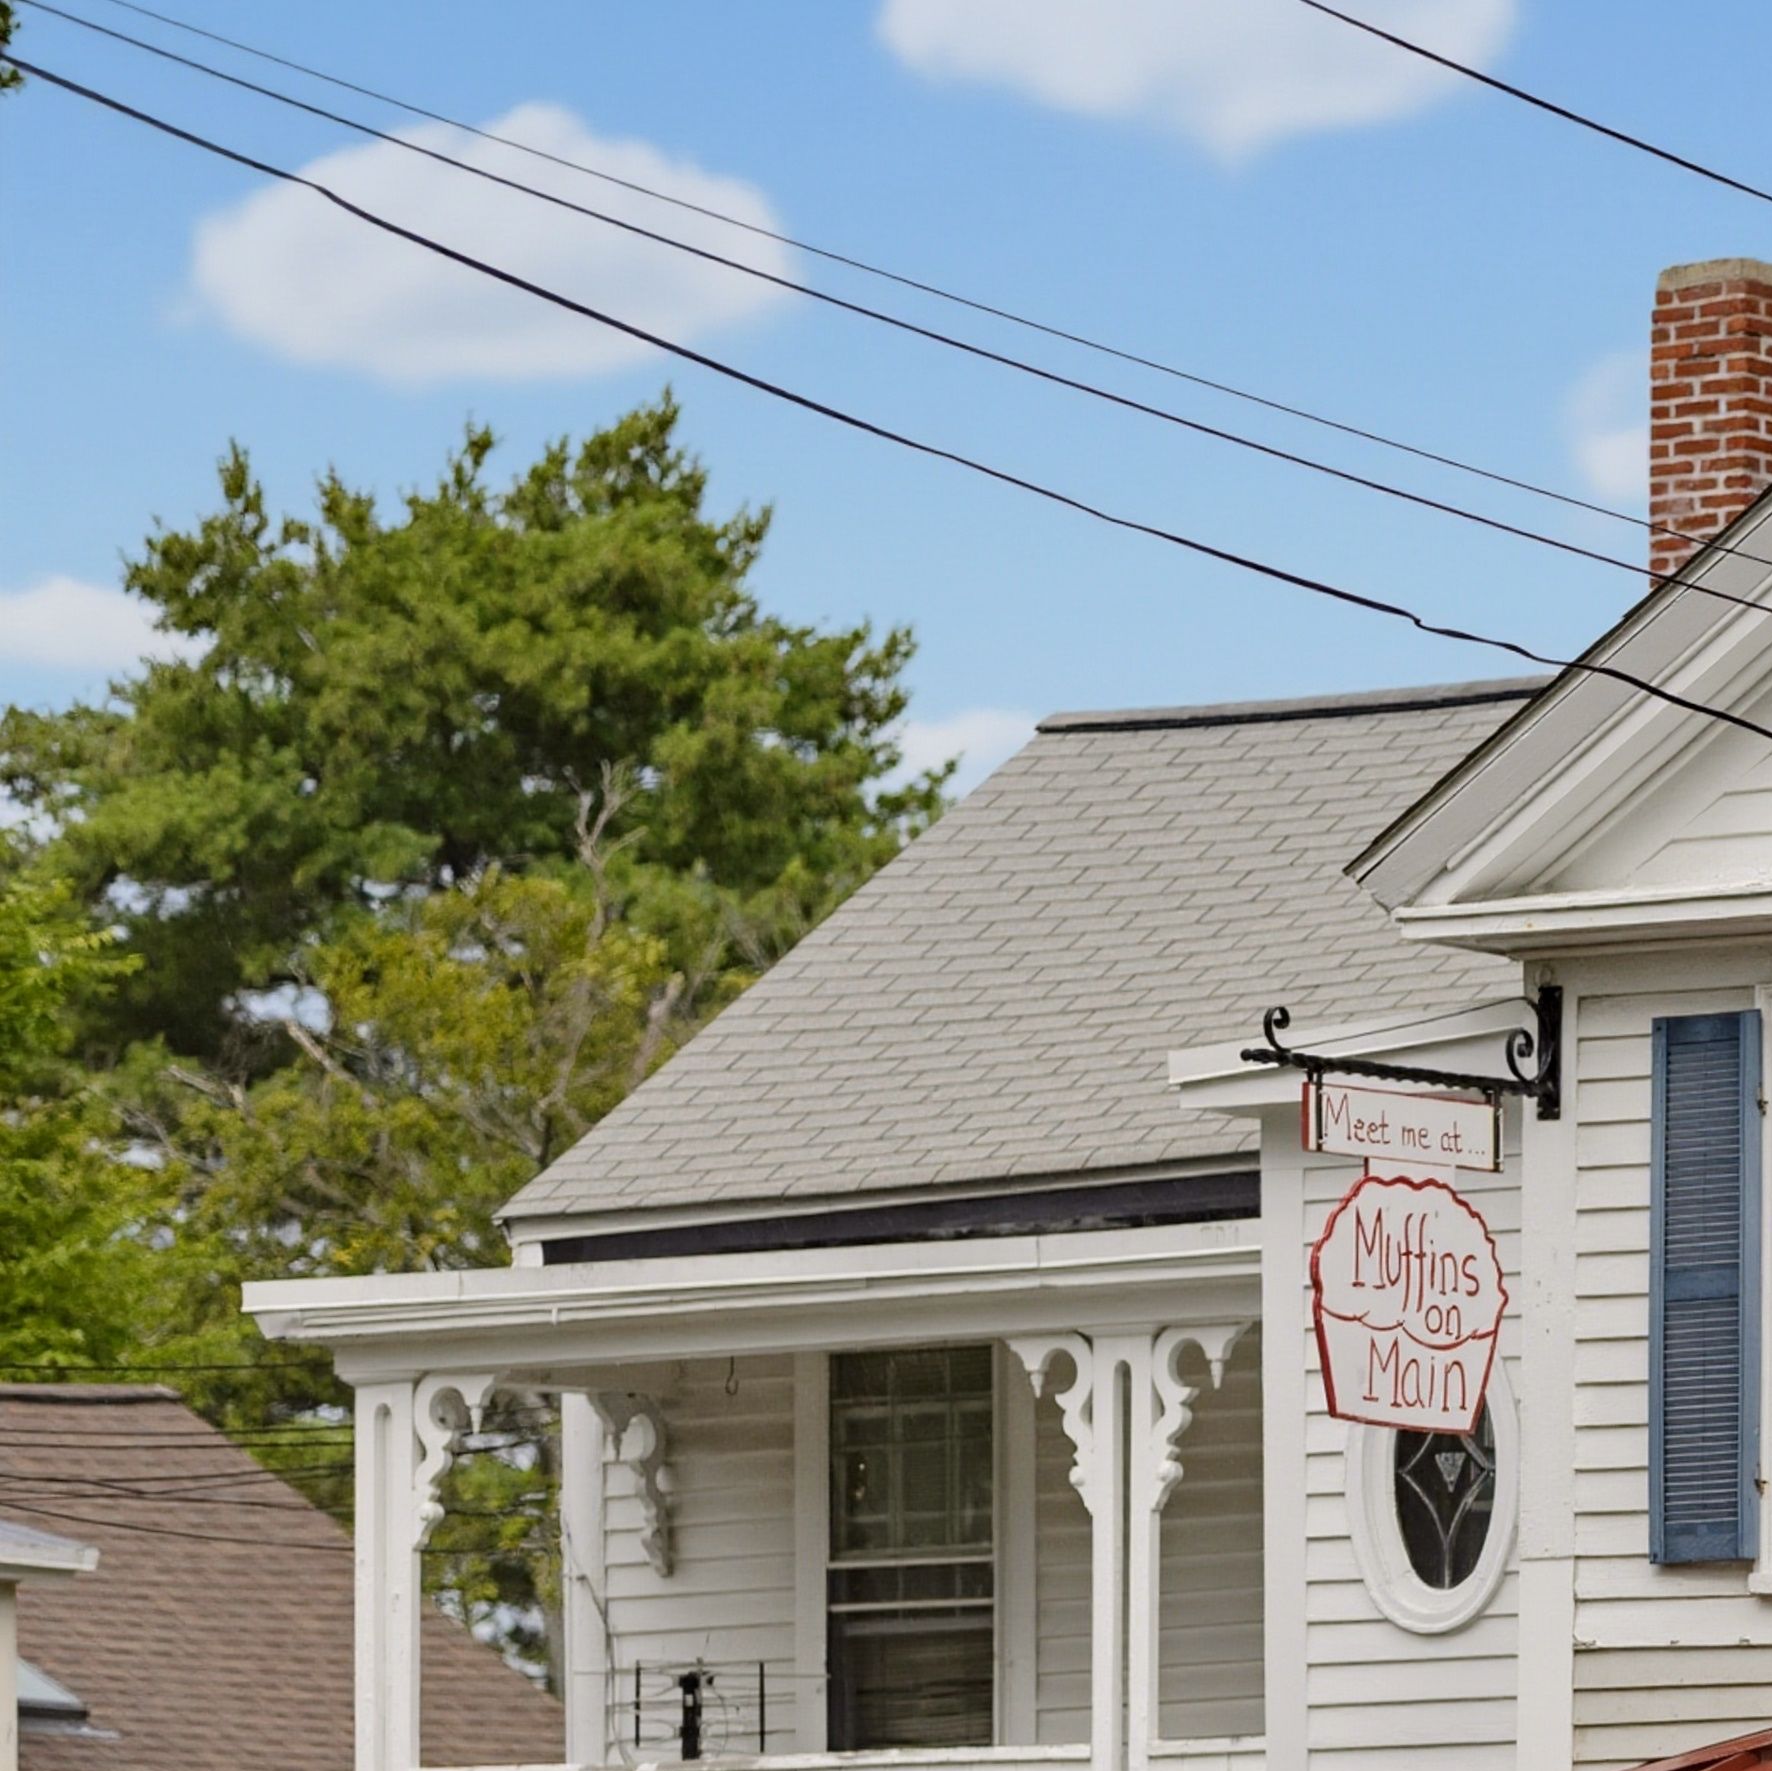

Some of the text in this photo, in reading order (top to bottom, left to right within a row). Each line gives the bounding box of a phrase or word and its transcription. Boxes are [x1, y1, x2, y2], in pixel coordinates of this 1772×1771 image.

[1324, 1093, 1391, 1145] Meet
[1401, 1126, 1431, 1149] me
[1352, 1206, 1480, 1312] Muffins
[1425, 1304, 1461, 1339] on
[1363, 1336, 1468, 1411] Main
